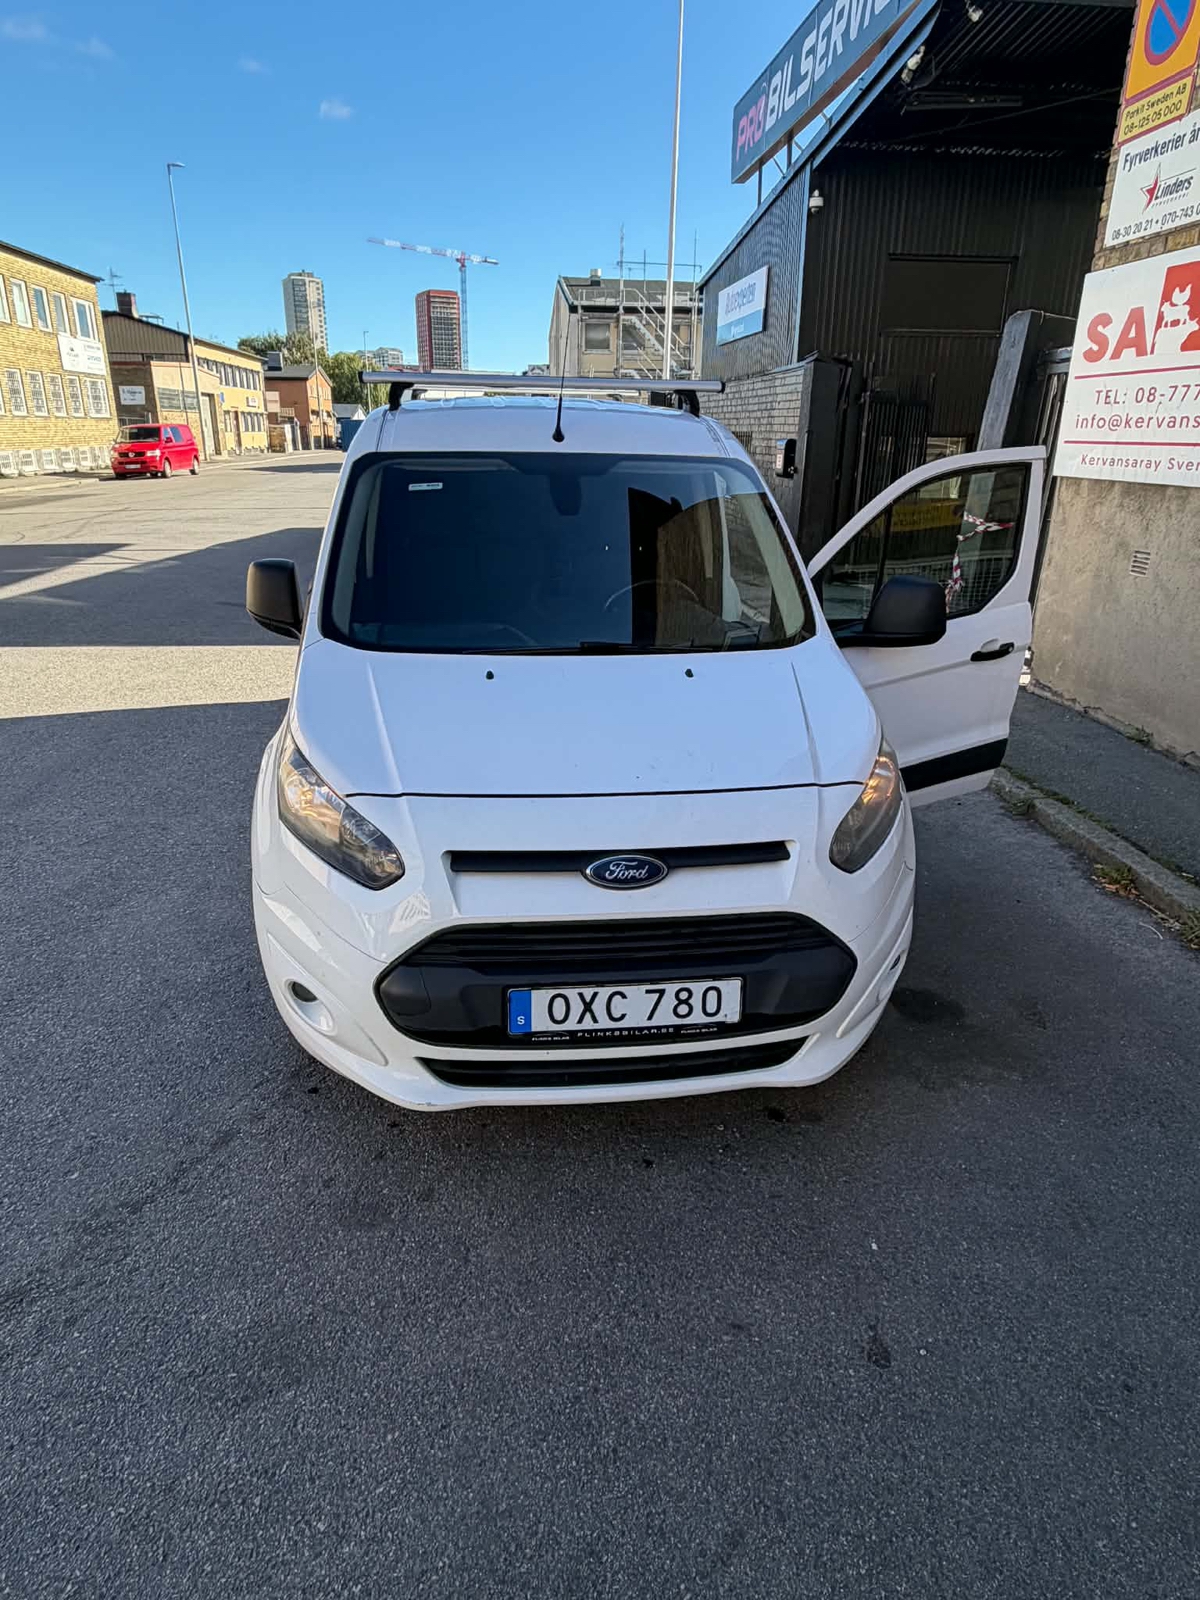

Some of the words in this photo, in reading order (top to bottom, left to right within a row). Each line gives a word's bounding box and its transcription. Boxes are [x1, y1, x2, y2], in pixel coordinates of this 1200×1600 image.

[765, 0, 891, 131] BILSERV
[1145, 92, 1174, 111] Sweden
[1175, 83, 1187, 97] AB
[1123, 114, 1151, 136] 08-125
[1150, 109, 1162, 123] 05
[1163, 100, 1183, 117] 000
[1122, 132, 1187, 173] Fyrverkerier
[1154, 175, 1194, 201] Linders
[1111, 225, 1132, 241] 08-30
[1132, 221, 1143, 234] 20
[1143, 218, 1154, 231] 21
[1161, 205, 1194, 226] 070-743
[1095, 388, 1127, 405] TEL:
[1075, 413, 1200, 432] info@kervans
[1080, 454, 1162, 472] Kervansaray
[605, 861, 649, 880] Ford
[517, 1015, 525, 1025] S
[547, 990, 629, 1026] OXC
[644, 985, 723, 1022] 780
